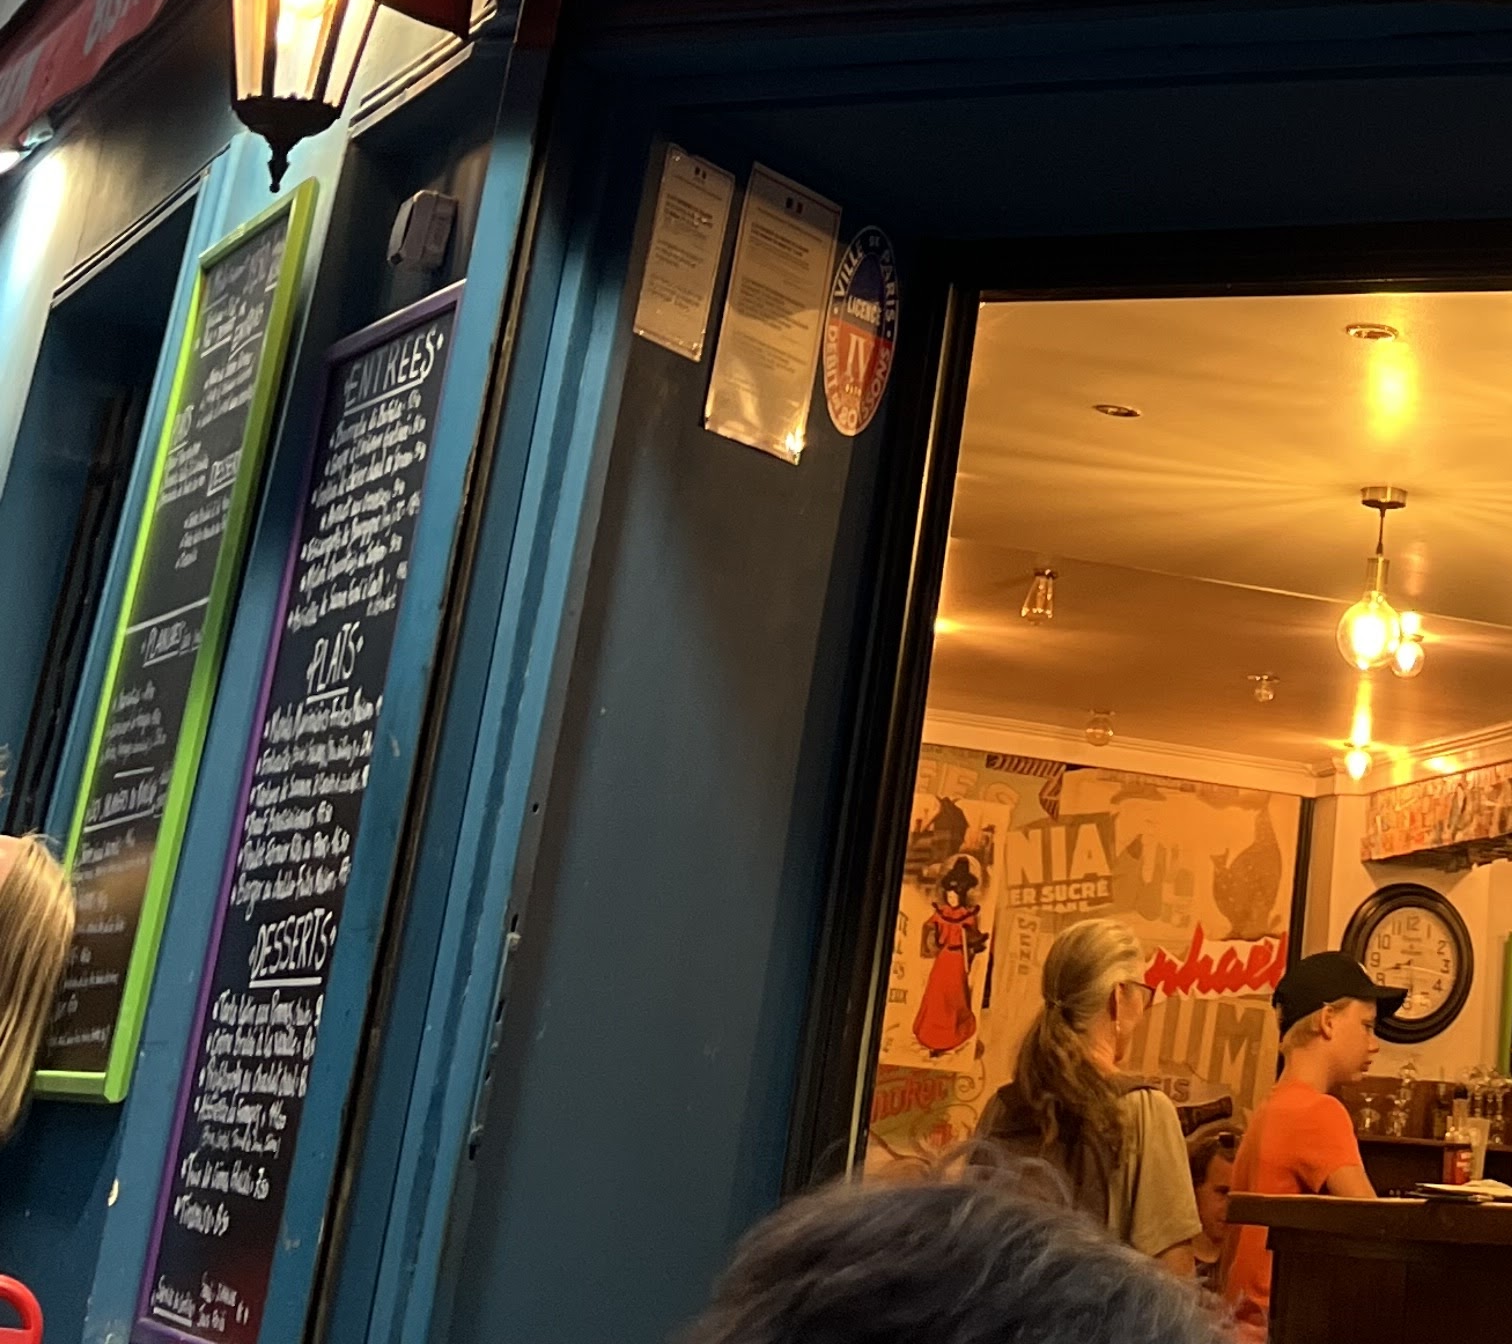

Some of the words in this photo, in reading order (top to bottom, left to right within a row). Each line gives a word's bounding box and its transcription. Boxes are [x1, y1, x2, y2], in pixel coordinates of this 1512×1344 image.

[833, 240, 865, 298] VILLE
[881, 249, 898, 323] PARIS
[845, 332, 876, 386] IV
[1406, 915, 1420, 931] 12
[1426, 923, 1431, 939] 1
[248, 909, 336, 981] DESSERTS
[1377, 933, 1391, 950] 10
[1436, 939, 1447, 955] 2
[1370, 951, 1381, 968] 9
[1432, 978, 1443, 993] 4
